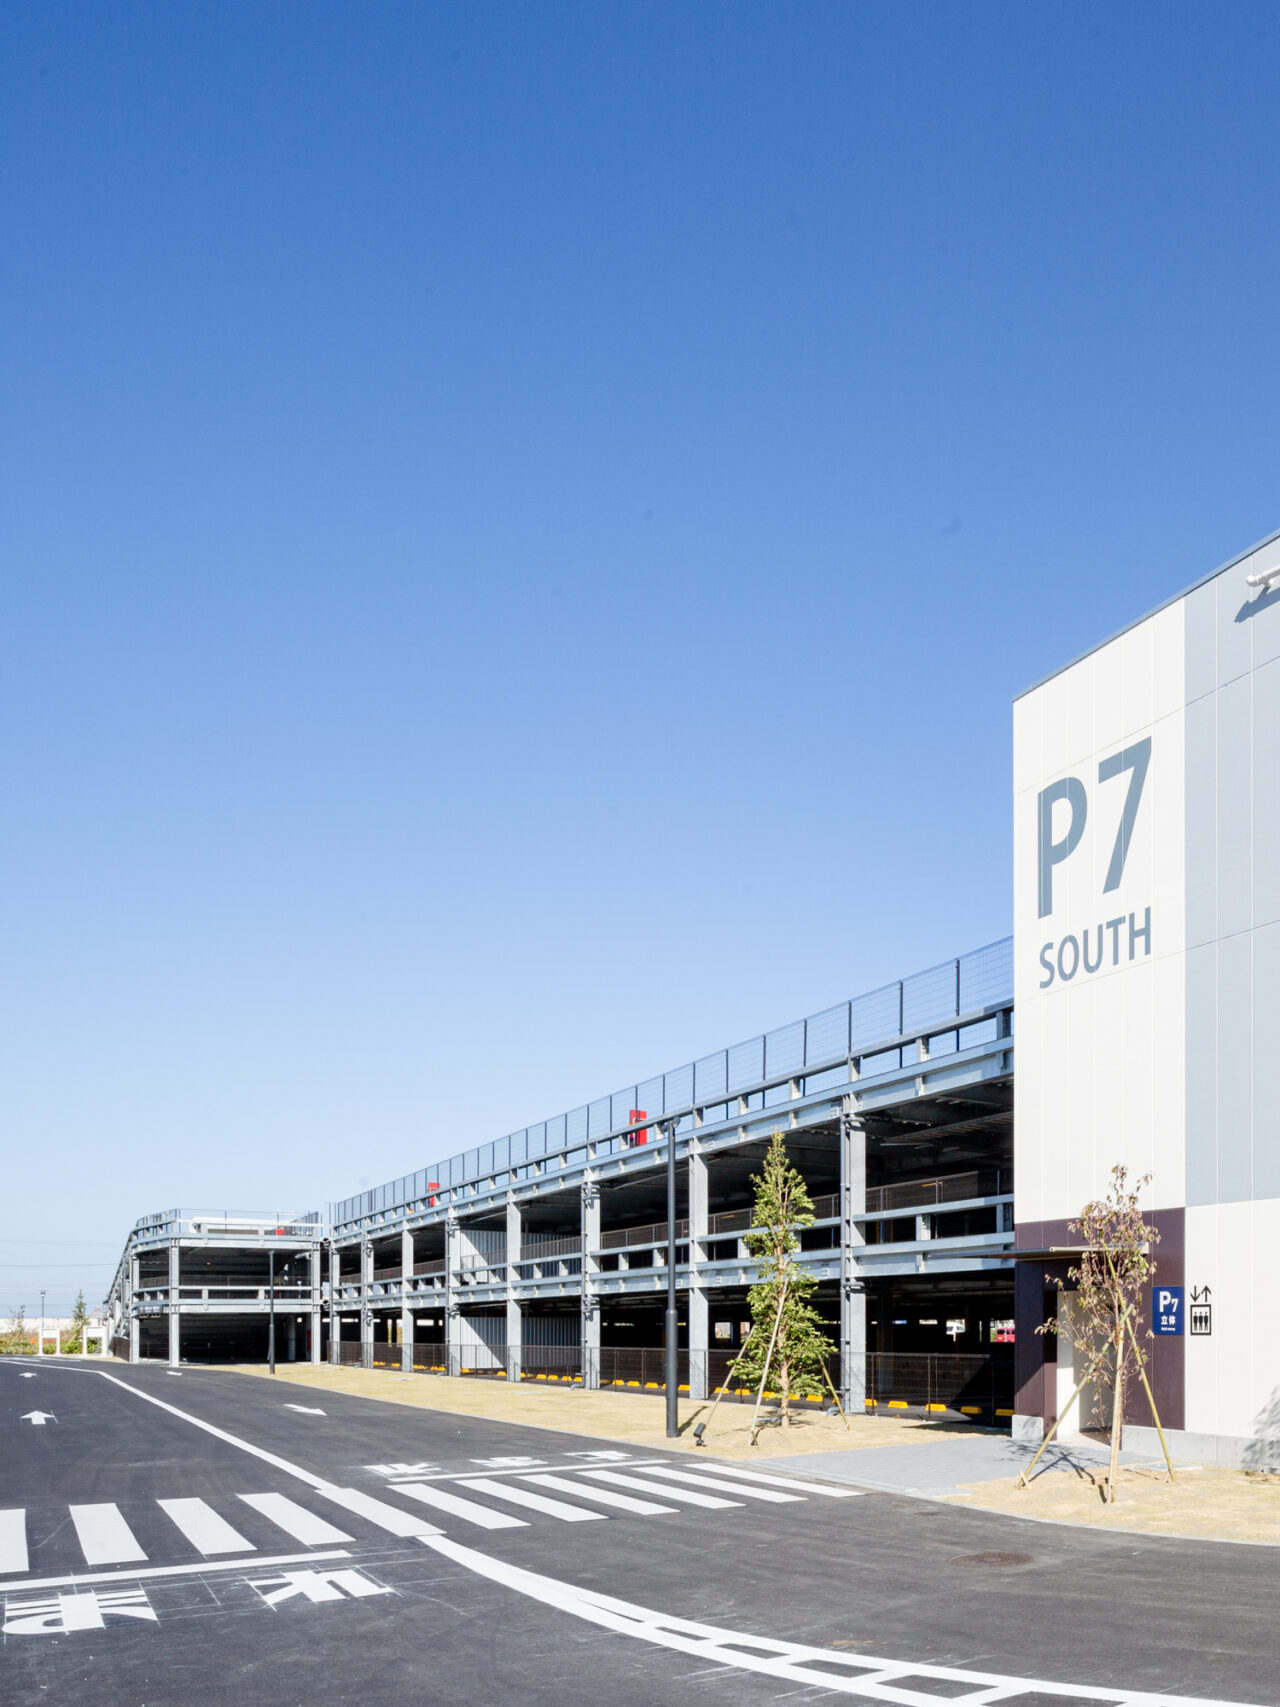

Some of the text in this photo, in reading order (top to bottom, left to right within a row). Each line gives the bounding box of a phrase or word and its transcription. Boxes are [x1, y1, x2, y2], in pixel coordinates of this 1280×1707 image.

[1037, 736, 1152, 919] P7
[1039, 906, 1152, 989] SOUTH
[1159, 1290, 1178, 1312] P7
[1160, 1315, 1176, 1325] 立体
